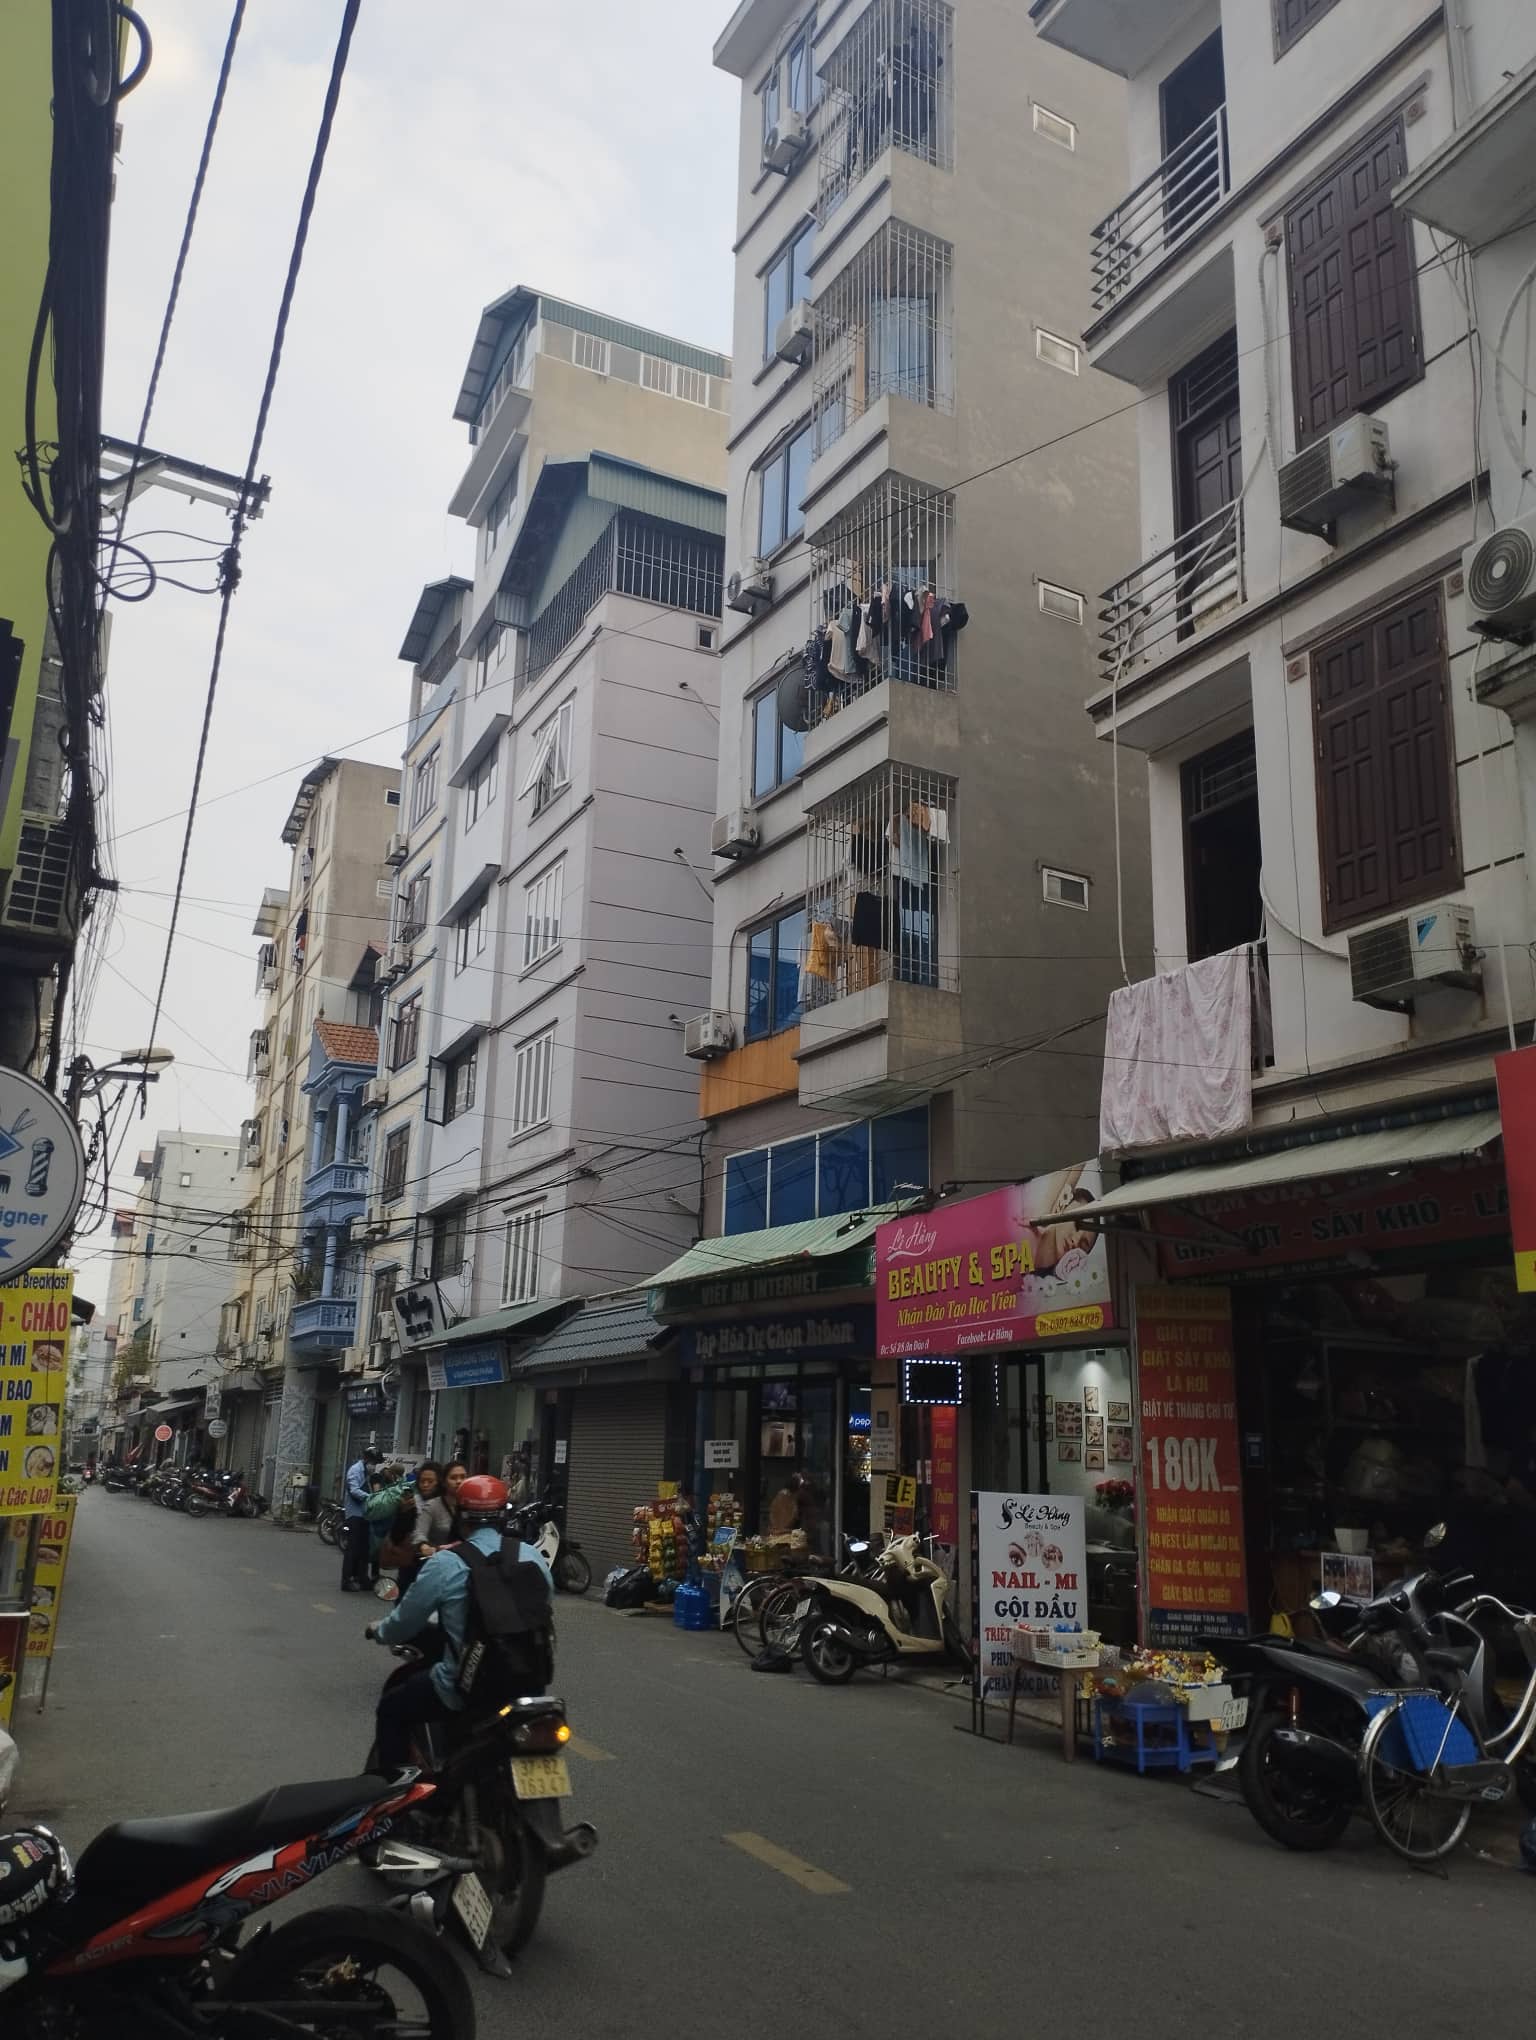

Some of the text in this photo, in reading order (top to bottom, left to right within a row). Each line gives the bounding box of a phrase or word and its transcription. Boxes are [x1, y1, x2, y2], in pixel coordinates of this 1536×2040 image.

[1312, 1208, 1366, 1241] SẤY
[1376, 1194, 1440, 1227] KHÔ
[23, 1272, 69, 1290] Breakfast
[888, 1239, 1036, 1301] BEAUTY & SPA
[22, 1296, 68, 1332] CHÁO
[897, 1290, 1017, 1329] Nhận Đào Tạo Học Viên
[957, 1331, 986, 1345] Facebook:
[1143, 1398, 1161, 1420] GIẶT
[7, 1486, 27, 1505] Các
[30, 1485, 54, 1508] Loại
[992, 1571, 1040, 1589] NAIL
[1055, 1573, 1078, 1590] MI
[995, 1593, 1077, 1622] GỘI ĐẦU
[985, 1623, 1012, 1646] TRIỆT
